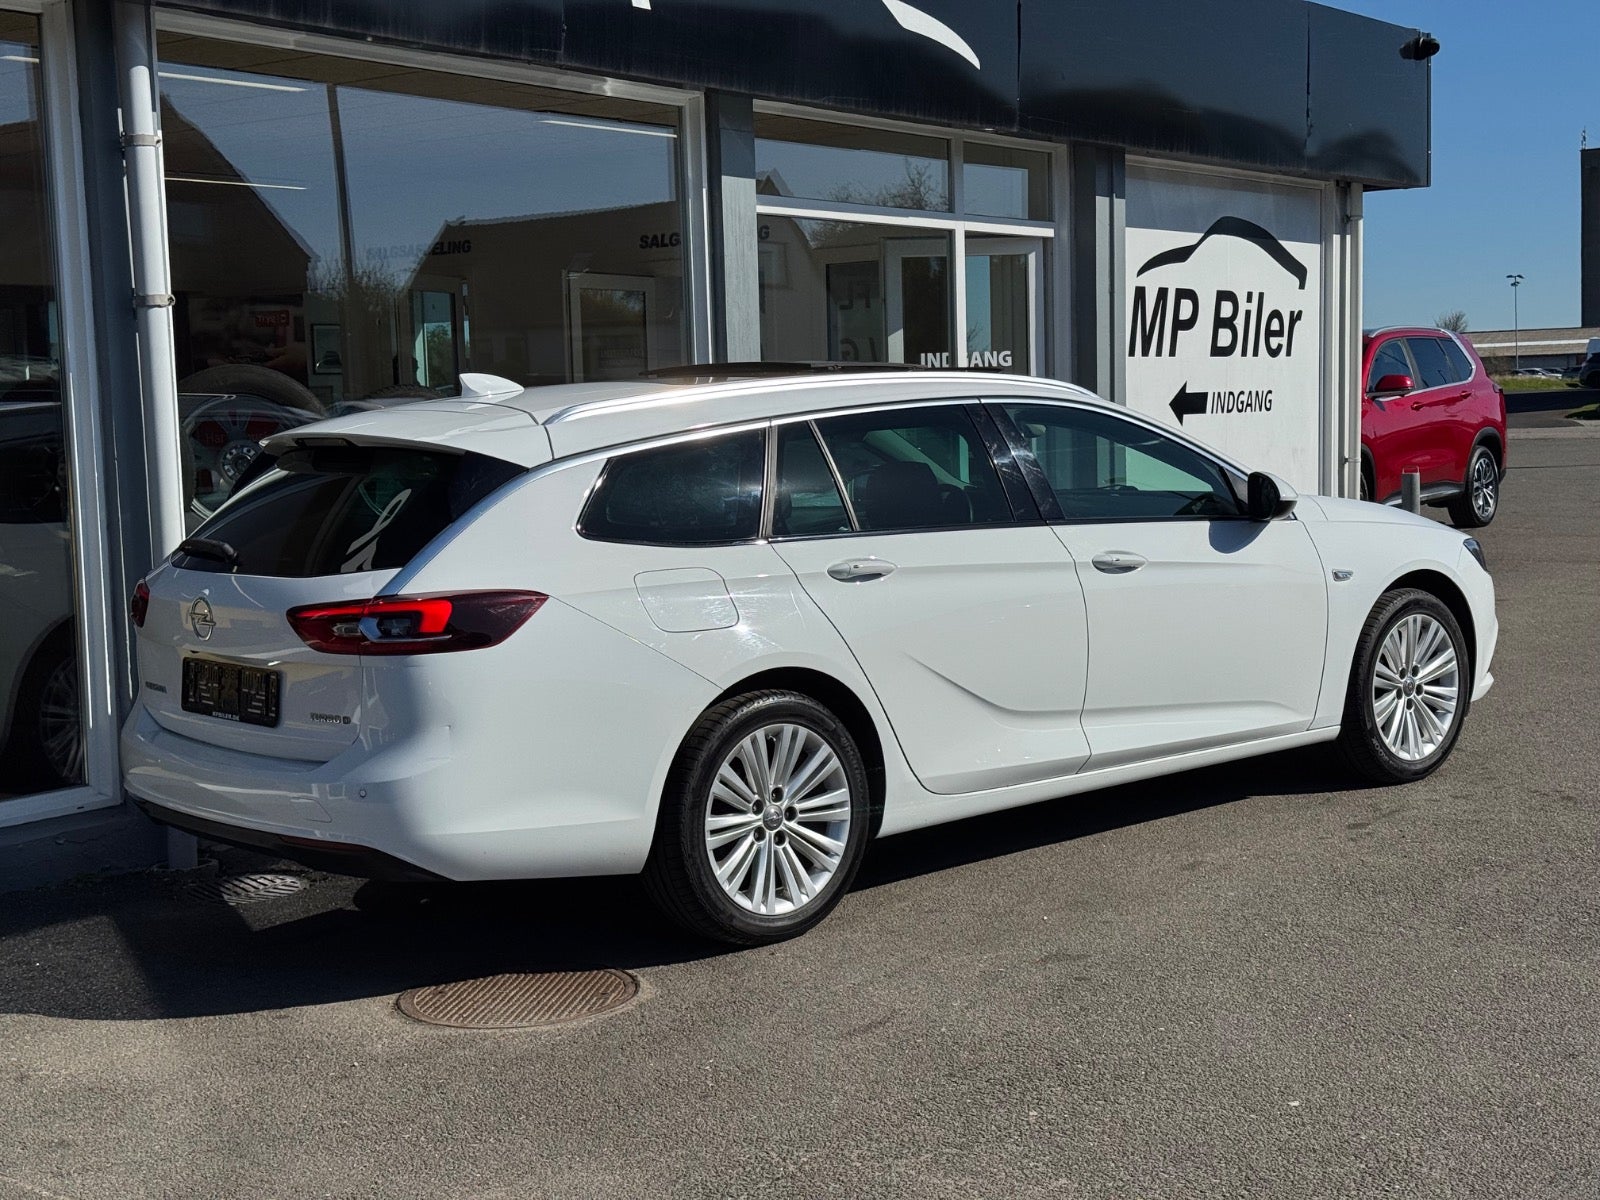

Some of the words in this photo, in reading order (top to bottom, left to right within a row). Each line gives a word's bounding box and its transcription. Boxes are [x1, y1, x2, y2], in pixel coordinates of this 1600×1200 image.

[1128, 286, 1200, 358] MP
[1210, 290, 1303, 358] Biler
[920, 350, 1013, 368] INDANG
[1211, 390, 1273, 414] INDGANG
